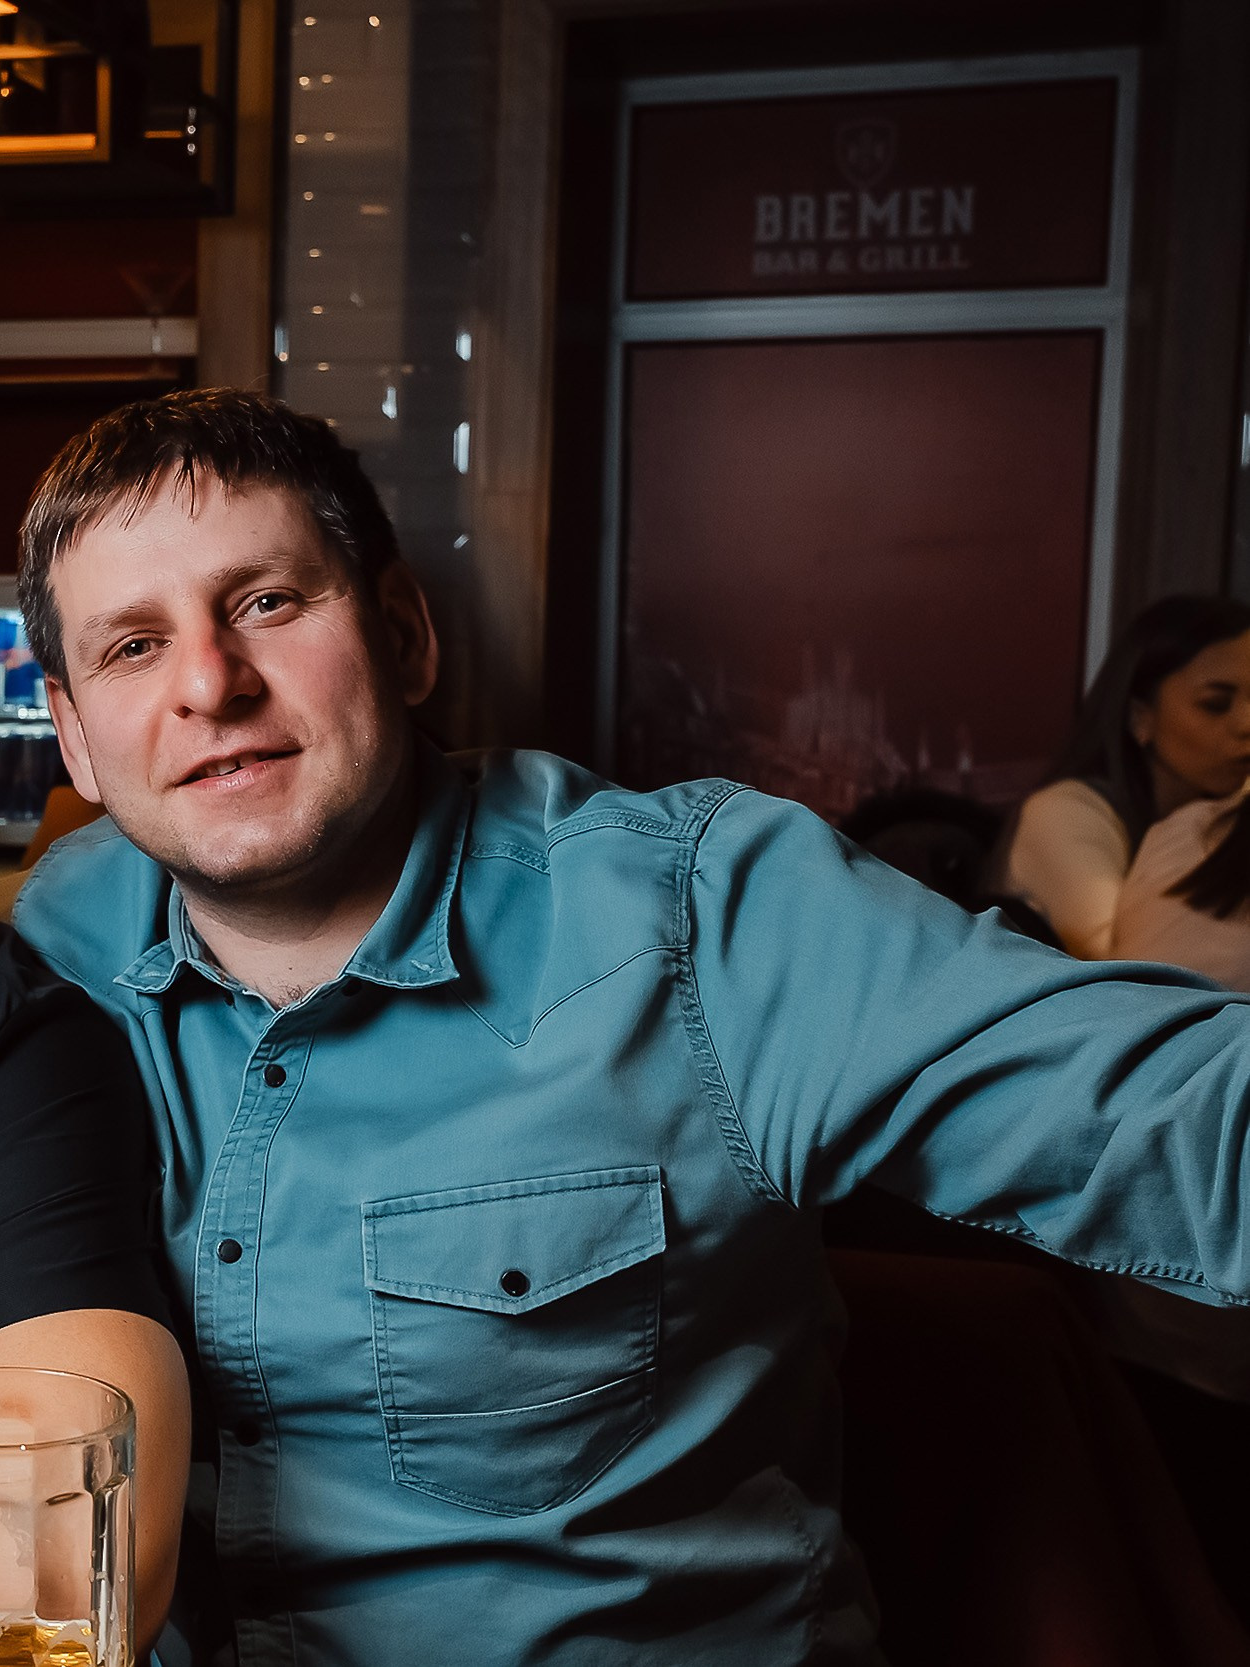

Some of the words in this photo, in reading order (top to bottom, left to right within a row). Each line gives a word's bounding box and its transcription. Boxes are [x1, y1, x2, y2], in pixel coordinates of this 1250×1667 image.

[753, 184, 977, 244] BREMEN
[751, 248, 818, 277] BAR
[826, 247, 850, 275] &
[857, 243, 971, 274] GRILL
